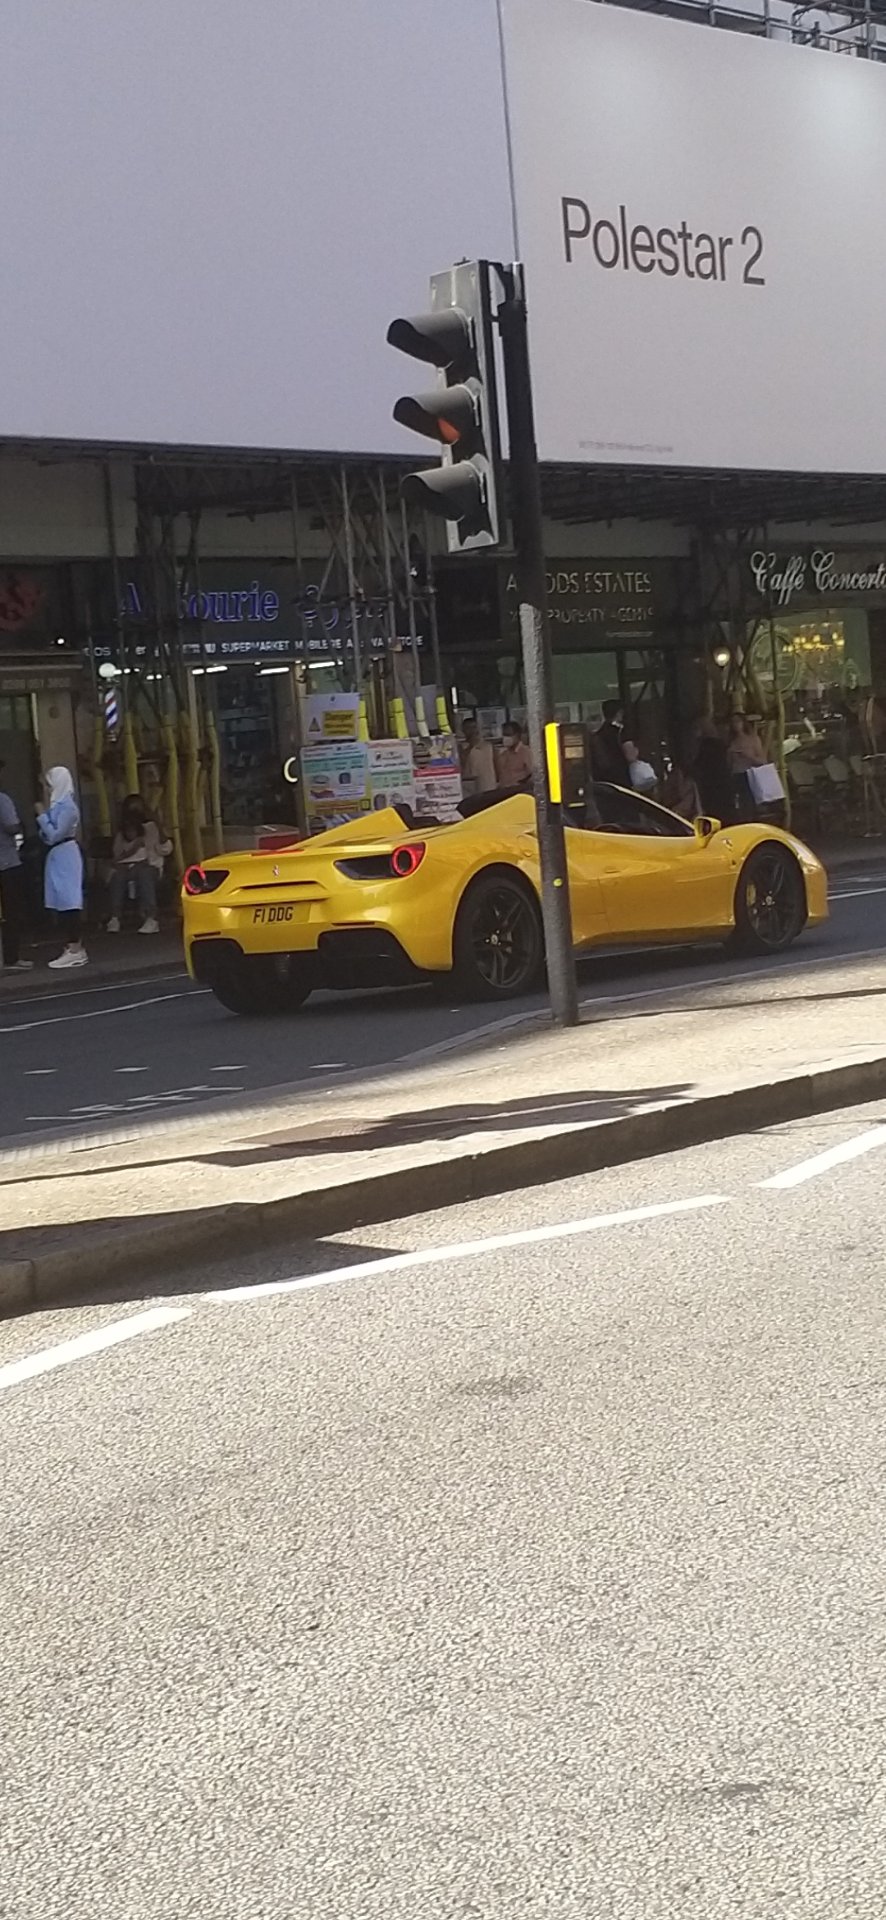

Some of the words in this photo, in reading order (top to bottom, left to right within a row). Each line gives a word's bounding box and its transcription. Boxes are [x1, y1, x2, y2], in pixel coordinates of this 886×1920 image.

[561, 196, 733, 281] Polestar
[741, 226, 766, 286] 2
[584, 571, 652, 594] ESTATES
[294, 638, 329, 651] MBILE
[268, 906, 294, 923] DDG
